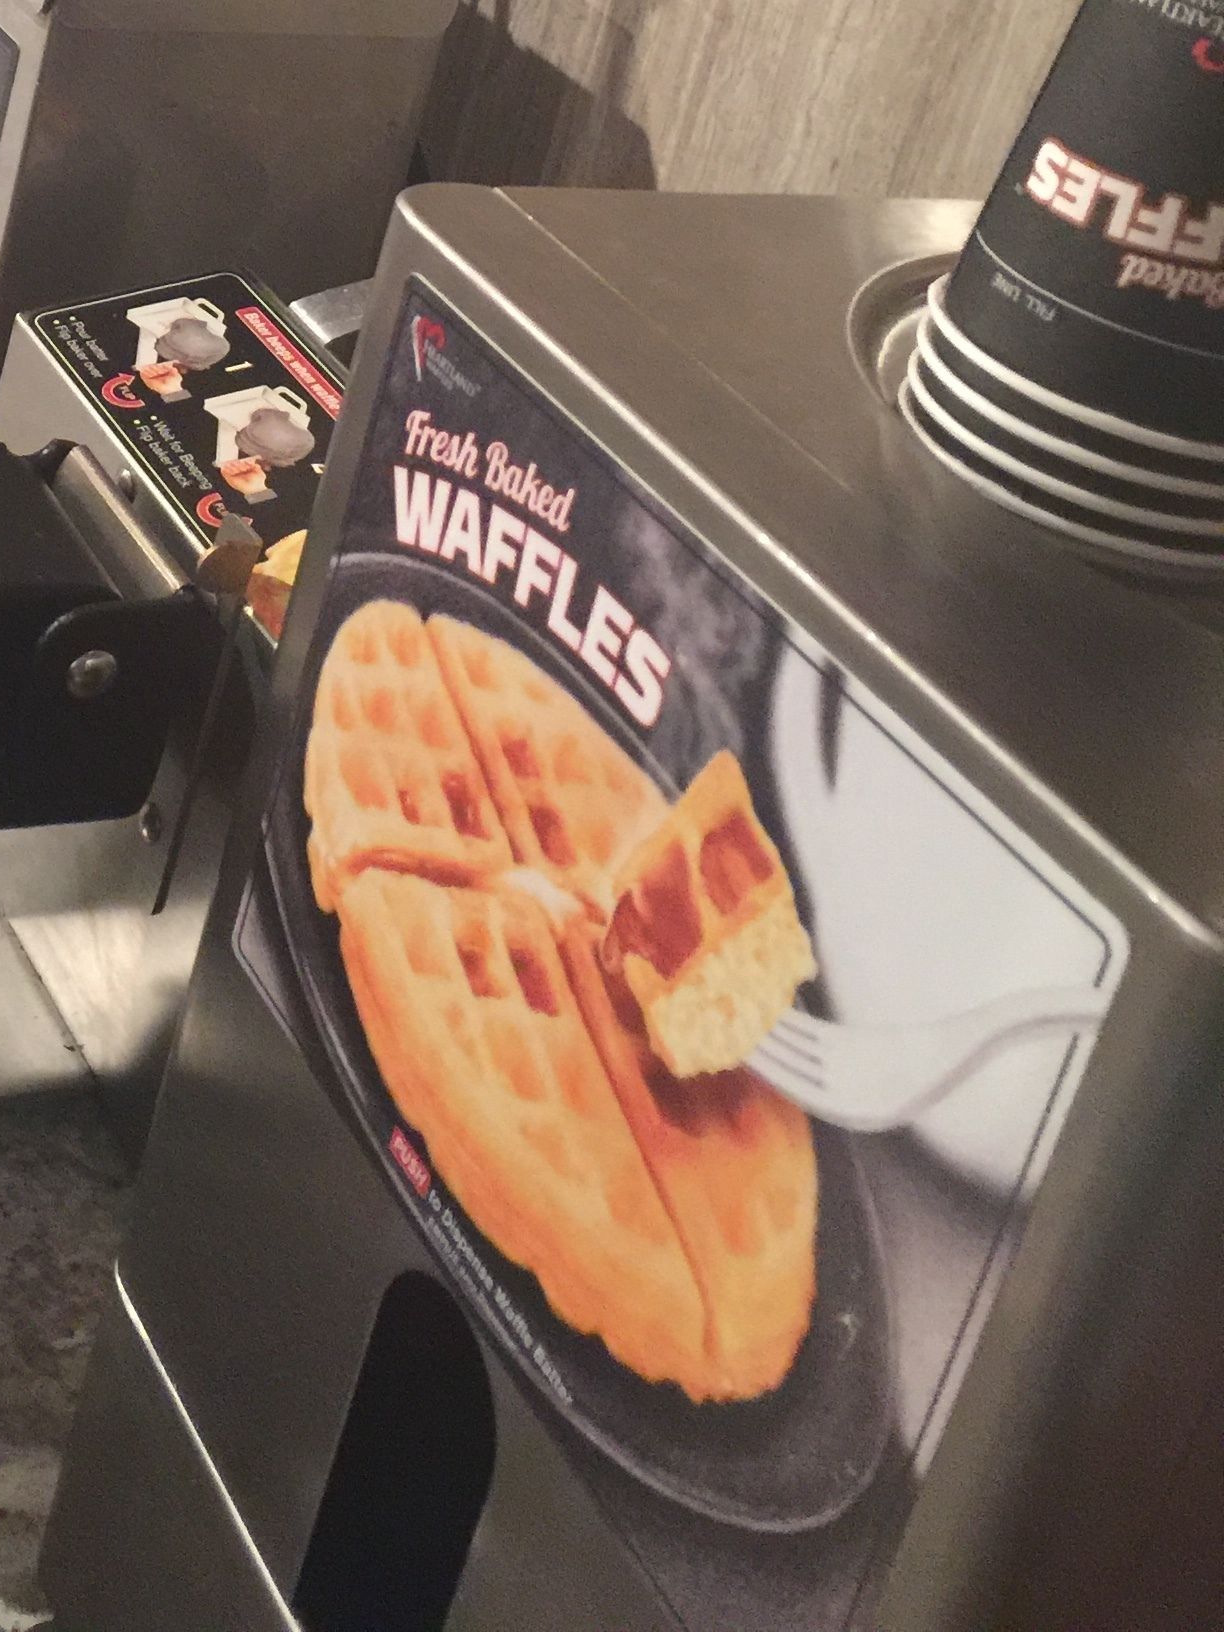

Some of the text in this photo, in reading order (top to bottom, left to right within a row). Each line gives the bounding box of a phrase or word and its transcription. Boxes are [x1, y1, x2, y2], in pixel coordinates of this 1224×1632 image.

[54, 324, 104, 378] Flip baker over
[72, 320, 92, 340] Pour
[265, 335, 295, 362] beeps
[136, 424, 193, 489] Flip baker back
[153, 420, 213, 490] Wait for Beeping
[404, 409, 575, 533] Fresh Baked
[392, 463, 673, 730] WAFFLES
[392, 1134, 427, 1186] PUSH
[427, 1188, 442, 1212] to
[441, 1207, 495, 1291] Dispense
[494, 1285, 534, 1349] Waffle
